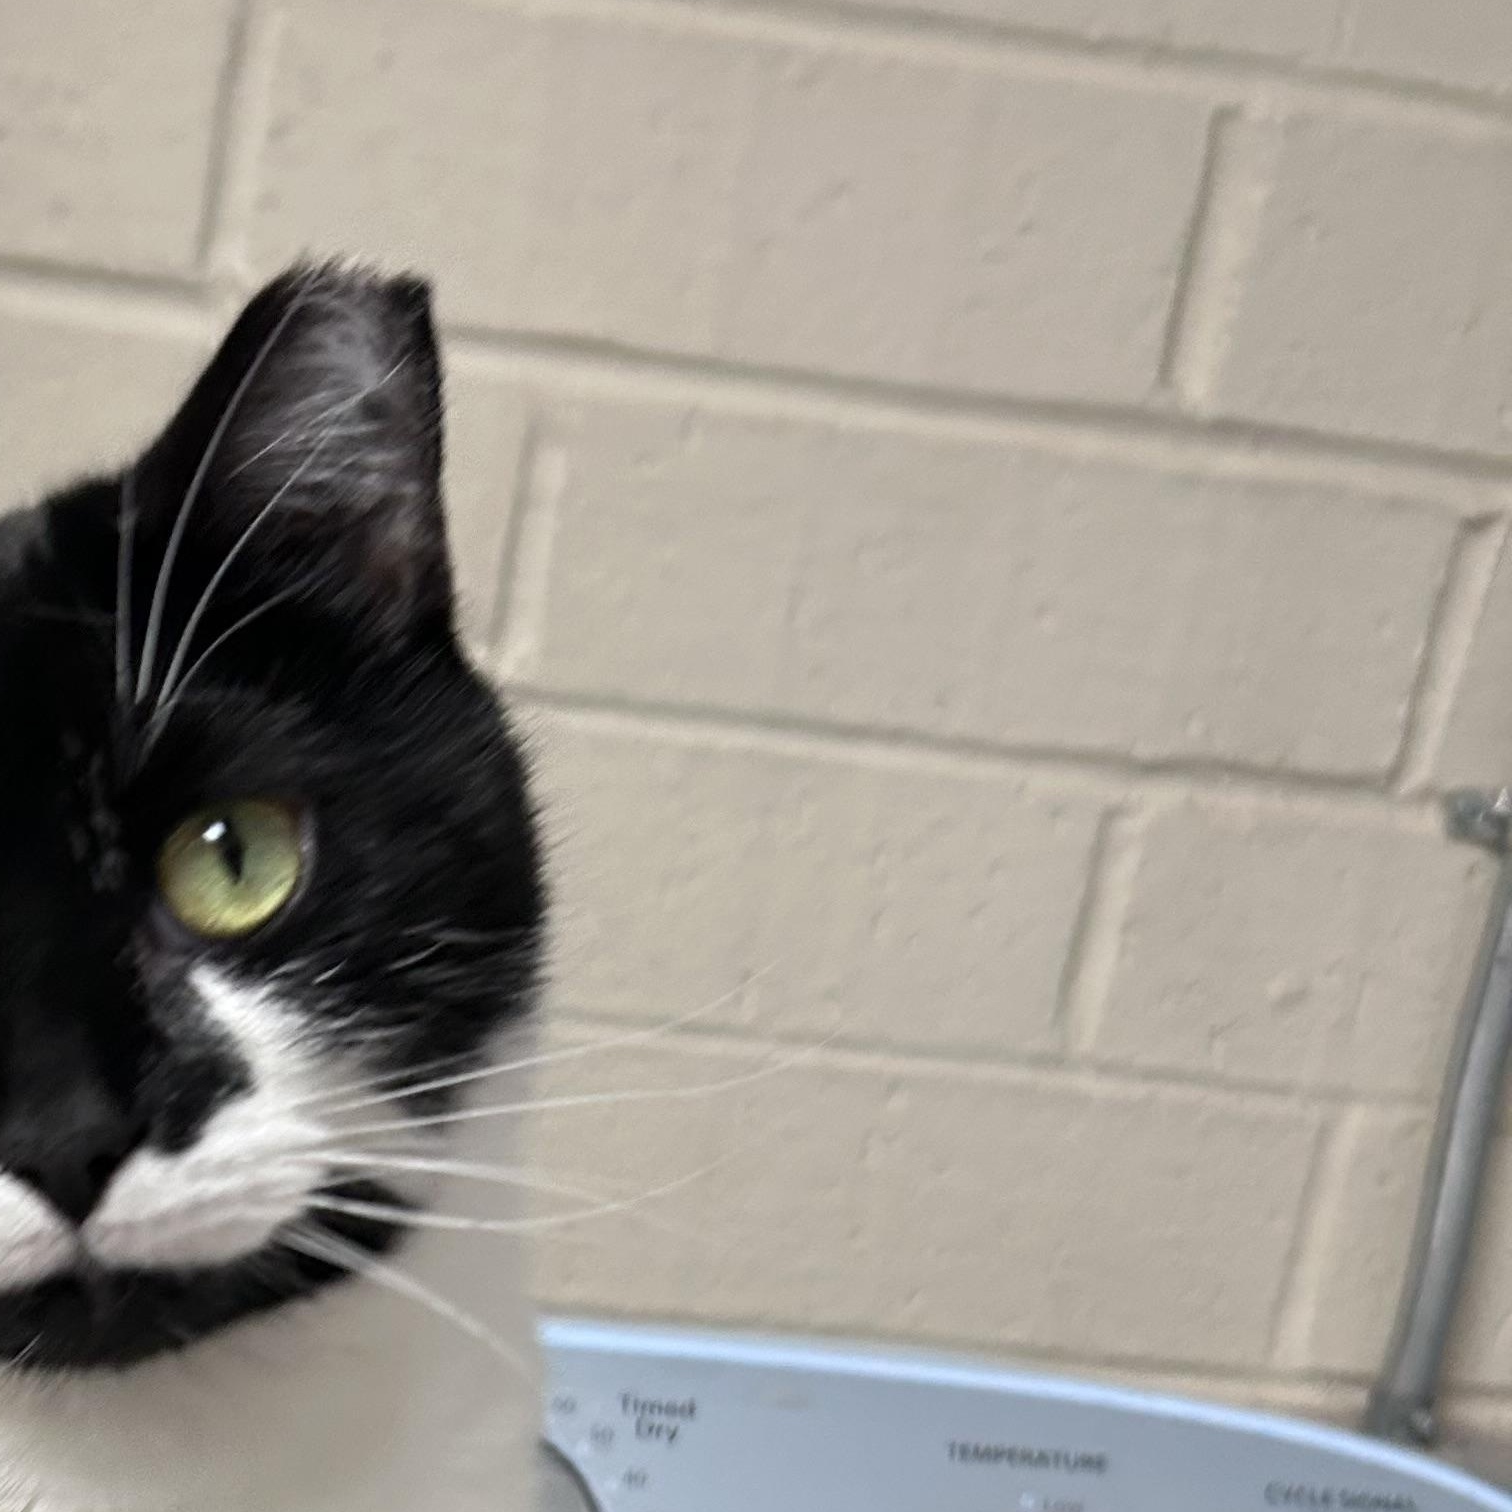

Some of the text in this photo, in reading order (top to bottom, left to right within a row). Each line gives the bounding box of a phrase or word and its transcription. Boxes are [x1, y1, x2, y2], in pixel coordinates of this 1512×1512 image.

[620, 1391, 697, 1421] Timed
[635, 1416, 679, 1443] Dry
[947, 1441, 1108, 1475] TEMPERATURE
